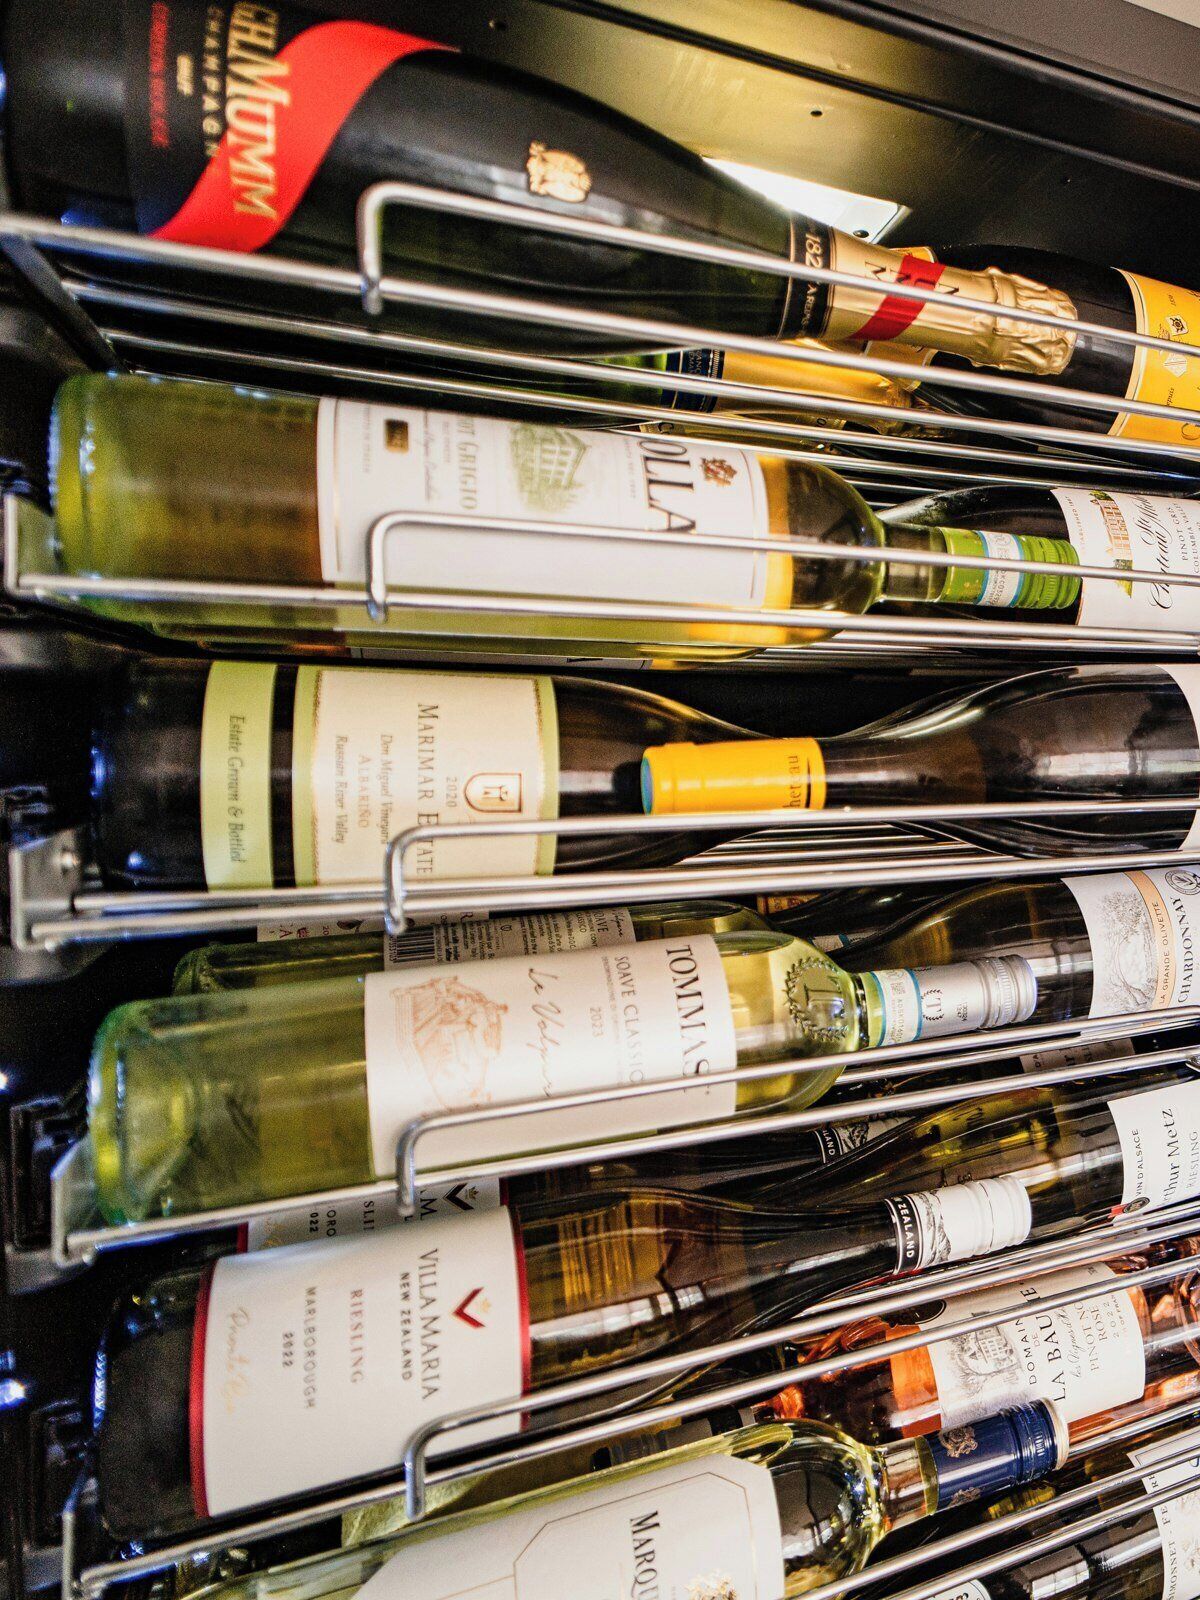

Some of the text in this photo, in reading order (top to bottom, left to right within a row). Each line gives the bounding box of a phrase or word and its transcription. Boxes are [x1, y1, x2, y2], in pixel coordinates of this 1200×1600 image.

[203, 5, 222, 160] CHAMPAGN
[805, 233, 824, 267] 182
[457, 442, 478, 509] GRIGIO
[638, 440, 697, 533] OLLA
[1148, 532, 1173, 609] Chteau
[1176, 530, 1189, 561] PINOT
[1187, 527, 1200, 574] COLUMBIA
[375, 759, 393, 798] Miguel
[380, 734, 393, 756] Don
[227, 714, 247, 862] Estate Grown & Bottled
[331, 735, 349, 844] Russian River Valley
[358, 755, 372, 829] ALBARIÑO
[416, 704, 440, 874] MARIMAR ETATE
[446, 776, 458, 808] 2020
[1151, 902, 1171, 1005] LA GRANDE OLIVETTE
[1169, 896, 1194, 1004] CHARDONNAY
[526, 1001, 564, 1100] Volpar
[614, 956, 645, 1083] SOAVE CLASSIC
[665, 945, 711, 1093] TOMMAS
[1131, 1129, 1144, 1197] VIN D'ALSACE
[1161, 1108, 1180, 1158] Metz
[308, 1212, 319, 1233] 022
[898, 1203, 915, 1258] ZEALAND
[282, 1331, 295, 1368] 2022
[303, 1287, 318, 1408] MARLBOROUGH
[350, 1289, 365, 1384] RIESLING
[400, 1272, 413, 1382] NEW ZEALAND
[419, 1248, 441, 1400] VILLA MARIA
[1020, 1291, 1067, 1403] LA BAUE
[1033, 1332, 1041, 1347] DE
[1082, 1326, 1100, 1372] PINOT
[1103, 1302, 1120, 1339] 2022
